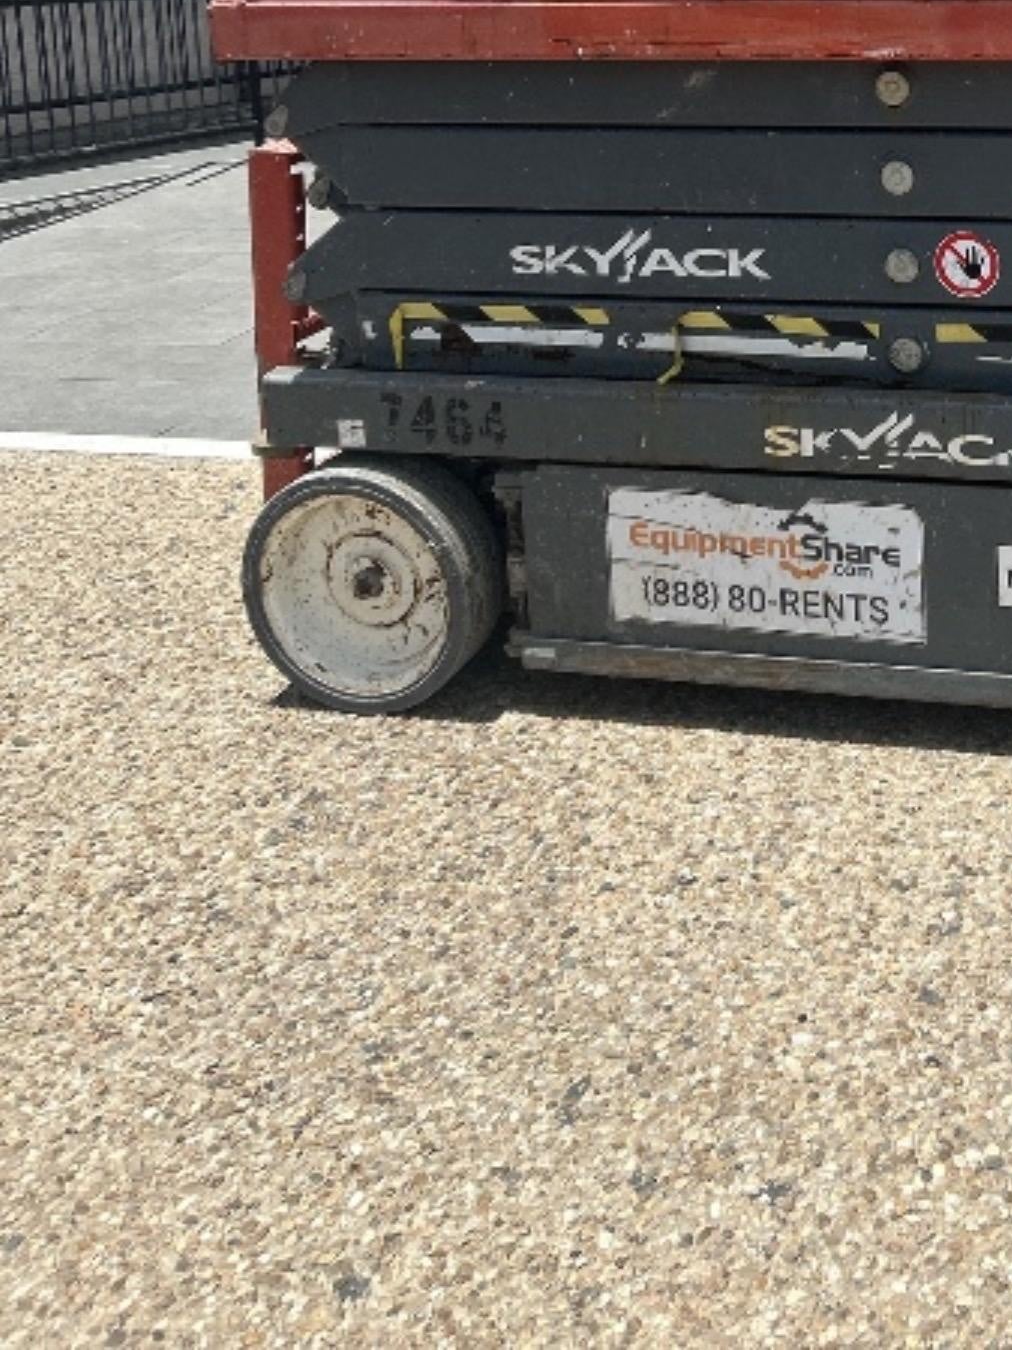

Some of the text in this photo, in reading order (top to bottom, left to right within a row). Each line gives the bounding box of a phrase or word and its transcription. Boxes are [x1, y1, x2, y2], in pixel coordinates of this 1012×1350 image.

[509, 228, 771, 283] SKYJACK
[642, 574, 890, 627] (888) 80-RENTS
